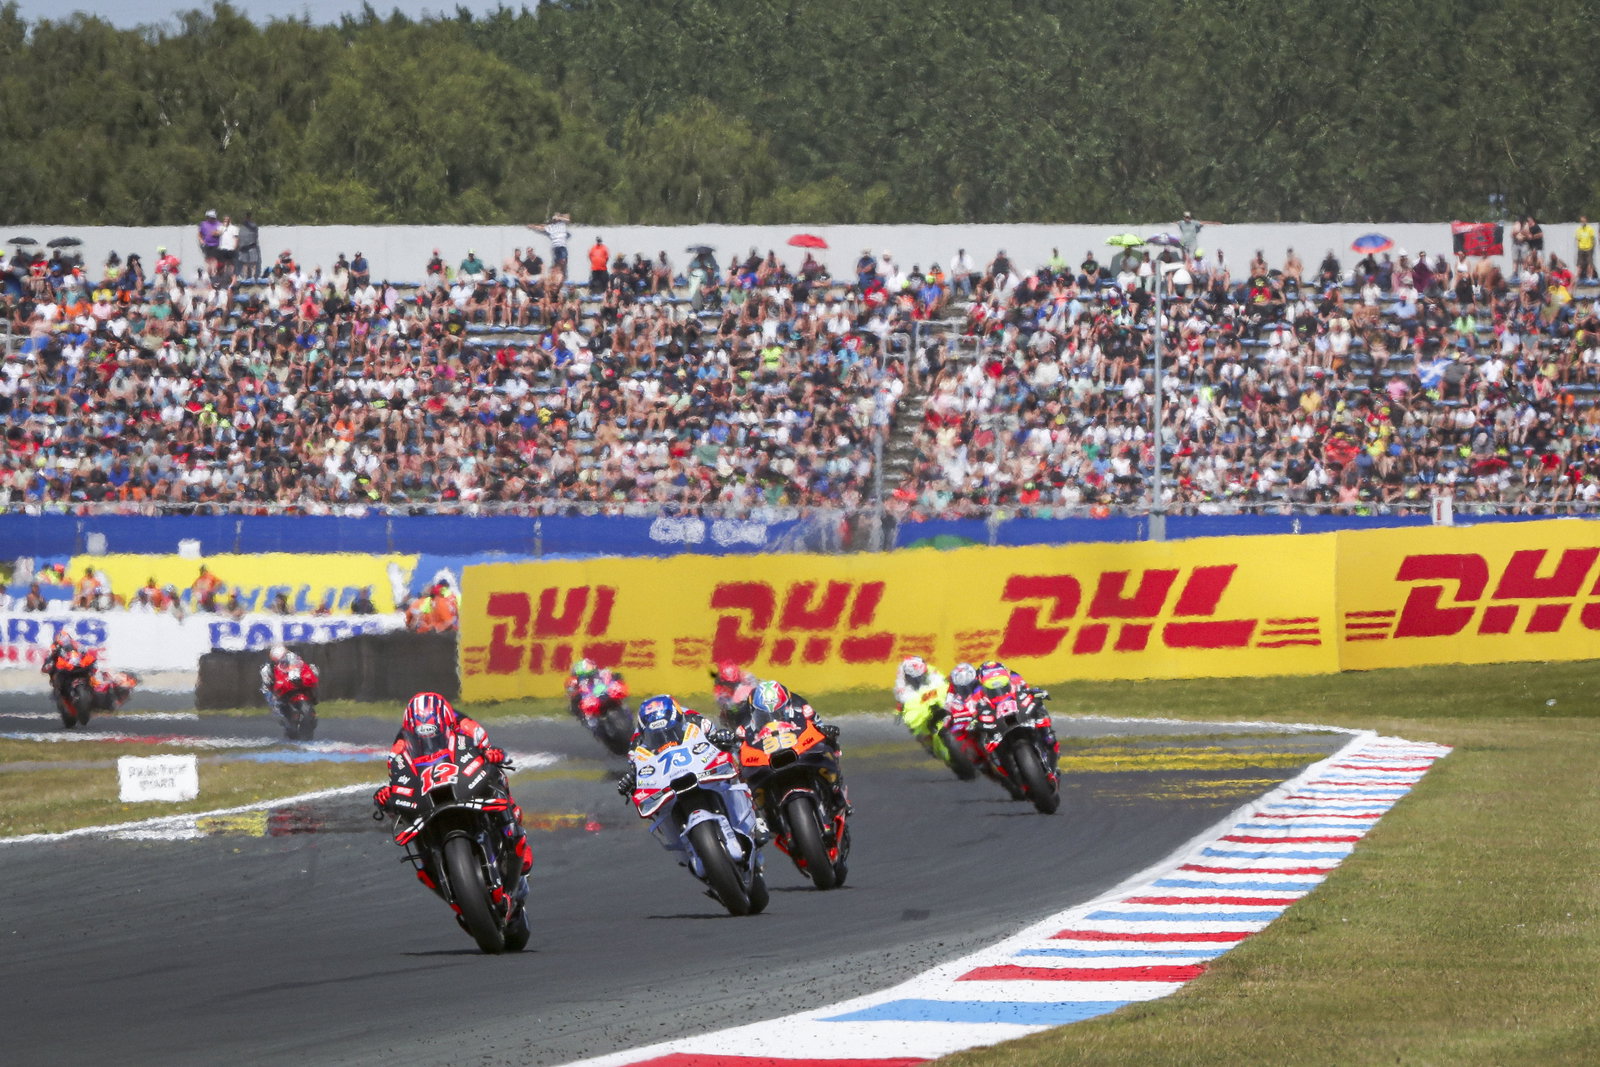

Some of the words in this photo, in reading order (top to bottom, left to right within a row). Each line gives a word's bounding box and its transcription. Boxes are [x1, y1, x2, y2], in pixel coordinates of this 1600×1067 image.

[485, 584, 627, 675] DHL
[710, 579, 896, 667] DHL
[996, 564, 1258, 659] DHL
[1394, 546, 1600, 639] DH
[657, 747, 693, 776] 73
